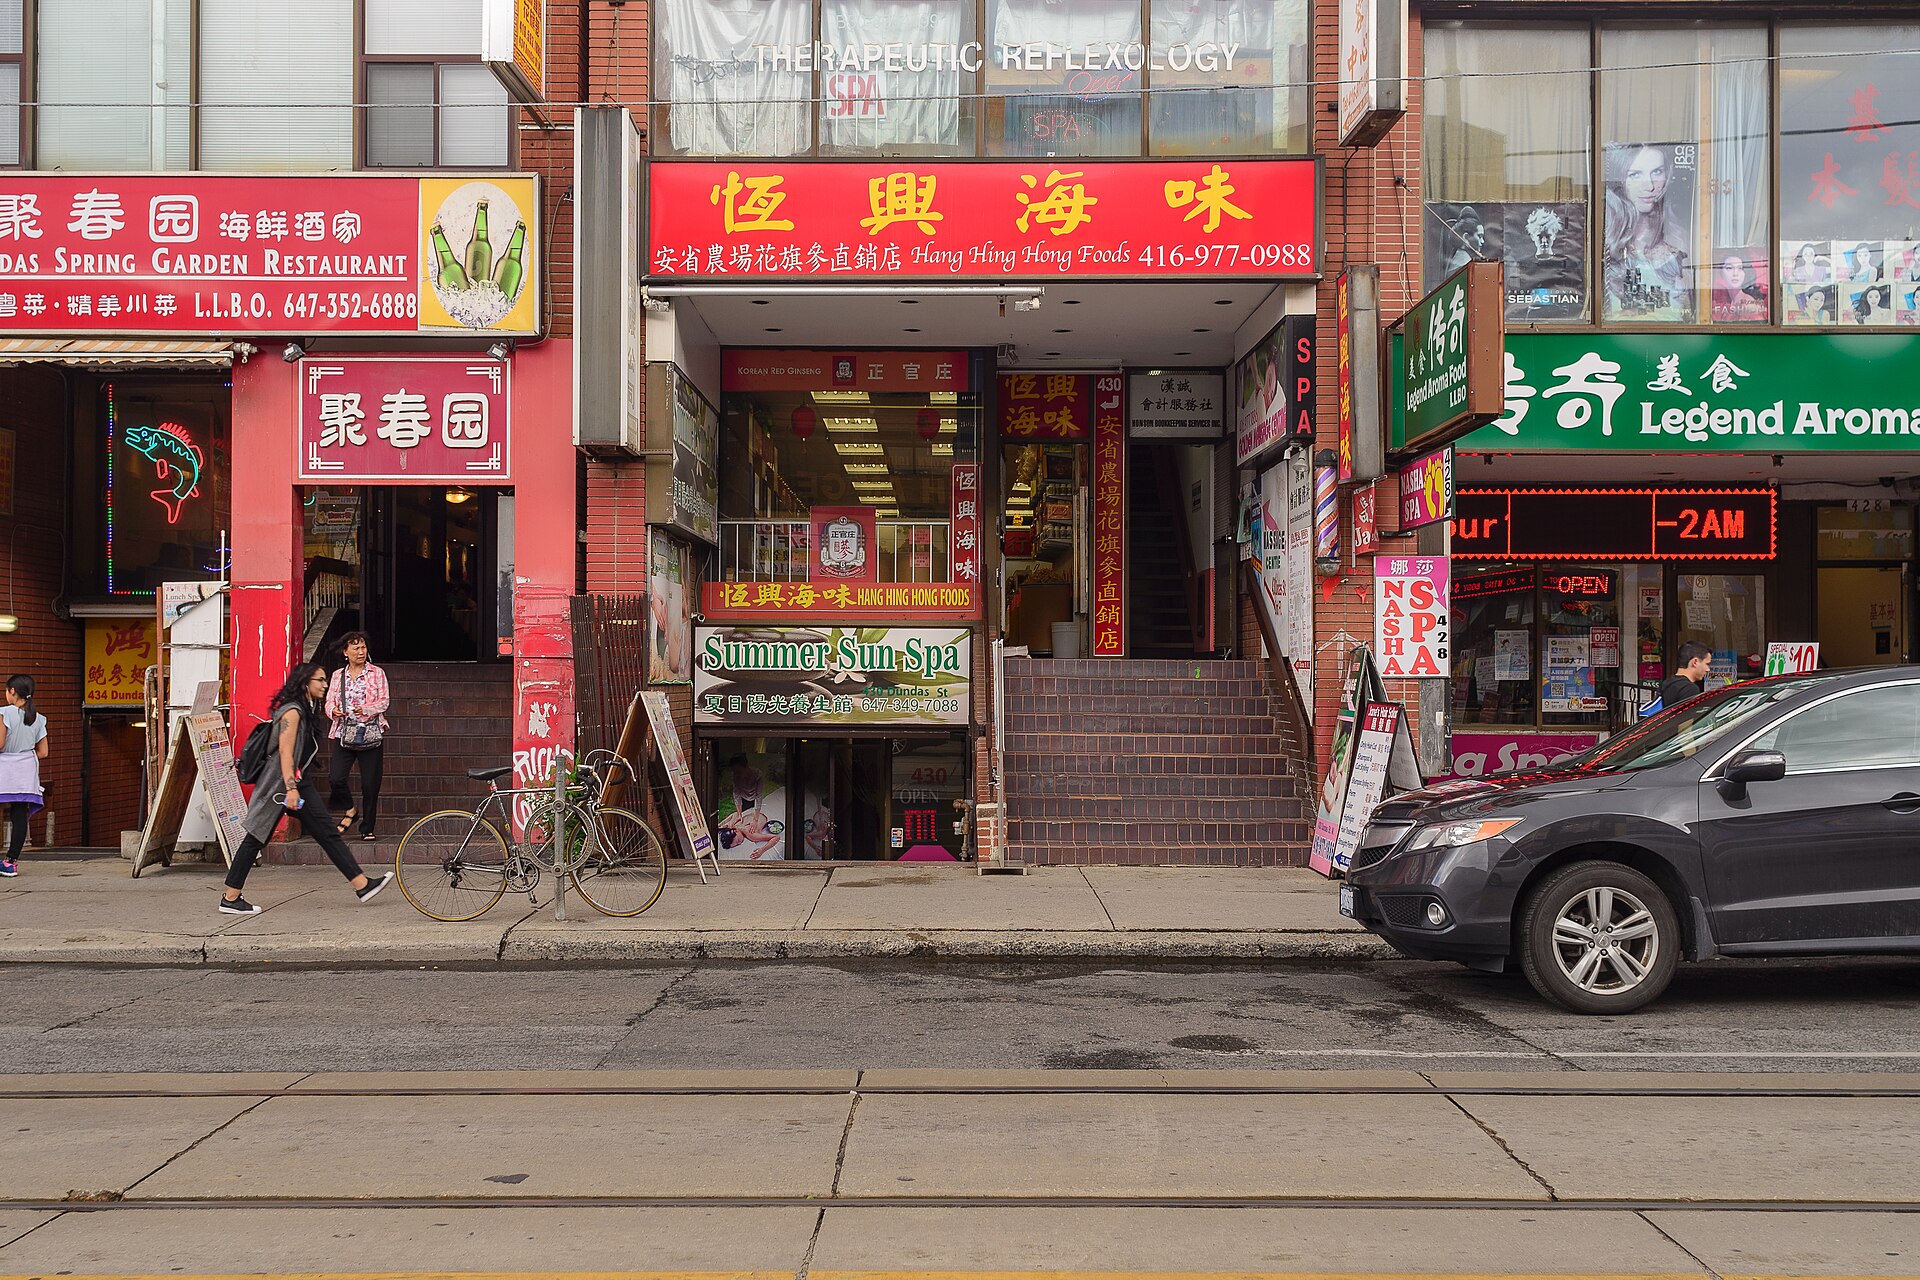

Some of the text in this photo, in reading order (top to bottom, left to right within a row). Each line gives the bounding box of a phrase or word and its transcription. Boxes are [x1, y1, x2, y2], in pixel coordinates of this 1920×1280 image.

[752, 41, 1240, 73] THERAPEUTIC REFLEXOLOGY
[828, 73, 885, 117] SPA
[1033, 114, 1081, 141] SPA
[0, 187, 199, 243] 聚春园
[54, 247, 136, 274] SPRING
[151, 247, 248, 274] GARDEN
[263, 248, 407, 275] RESTAURANT
[910, 240, 1311, 272] Hang Hing Hong Foods 416-977-0988
[194, 292, 417, 319] L.L.B.O. 647-352-6888
[1507, 295, 1579, 304] SEBASTIAN
[737, 366, 822, 375] KOREAN RED GINSENG
[867, 362, 953, 380] 正官庄
[1406, 354, 1467, 413] Legend Aroma Food
[1646, 353, 1751, 396] 美食
[1097, 377, 1122, 392] 430
[1296, 337, 1312, 435] SPA
[1449, 384, 1467, 408] LLBO
[318, 388, 490, 449] 聚春园
[1006, 404, 1081, 437] 海味
[1188, 419, 1210, 427] SERVICES
[1639, 399, 1920, 442] Legend Aroma
[1401, 466, 1424, 496] NASHA
[1405, 496, 1421, 522] SPA
[1852, 500, 1882, 512] 428
[830, 530, 856, 539] 正官庄
[1390, 559, 1434, 576] 娜莎
[857, 588, 970, 606] HANG HING HONG FOODS
[1558, 576, 1609, 594] OPEN
[105, 621, 151, 659] 鴻
[1382, 580, 1405, 675] NASHA
[1409, 580, 1441, 675] SPA
[1437, 615, 1448, 660] 428
[1594, 633, 1616, 642] OPEN
[702, 634, 960, 680] Summer Sun Spa
[88, 689, 145, 701] 434 Dunda
[861, 685, 948, 698] 430 Dundas St
[861, 698, 959, 713] 647-349-7088
[911, 767, 947, 785] 430
[900, 788, 939, 804] OPEN
